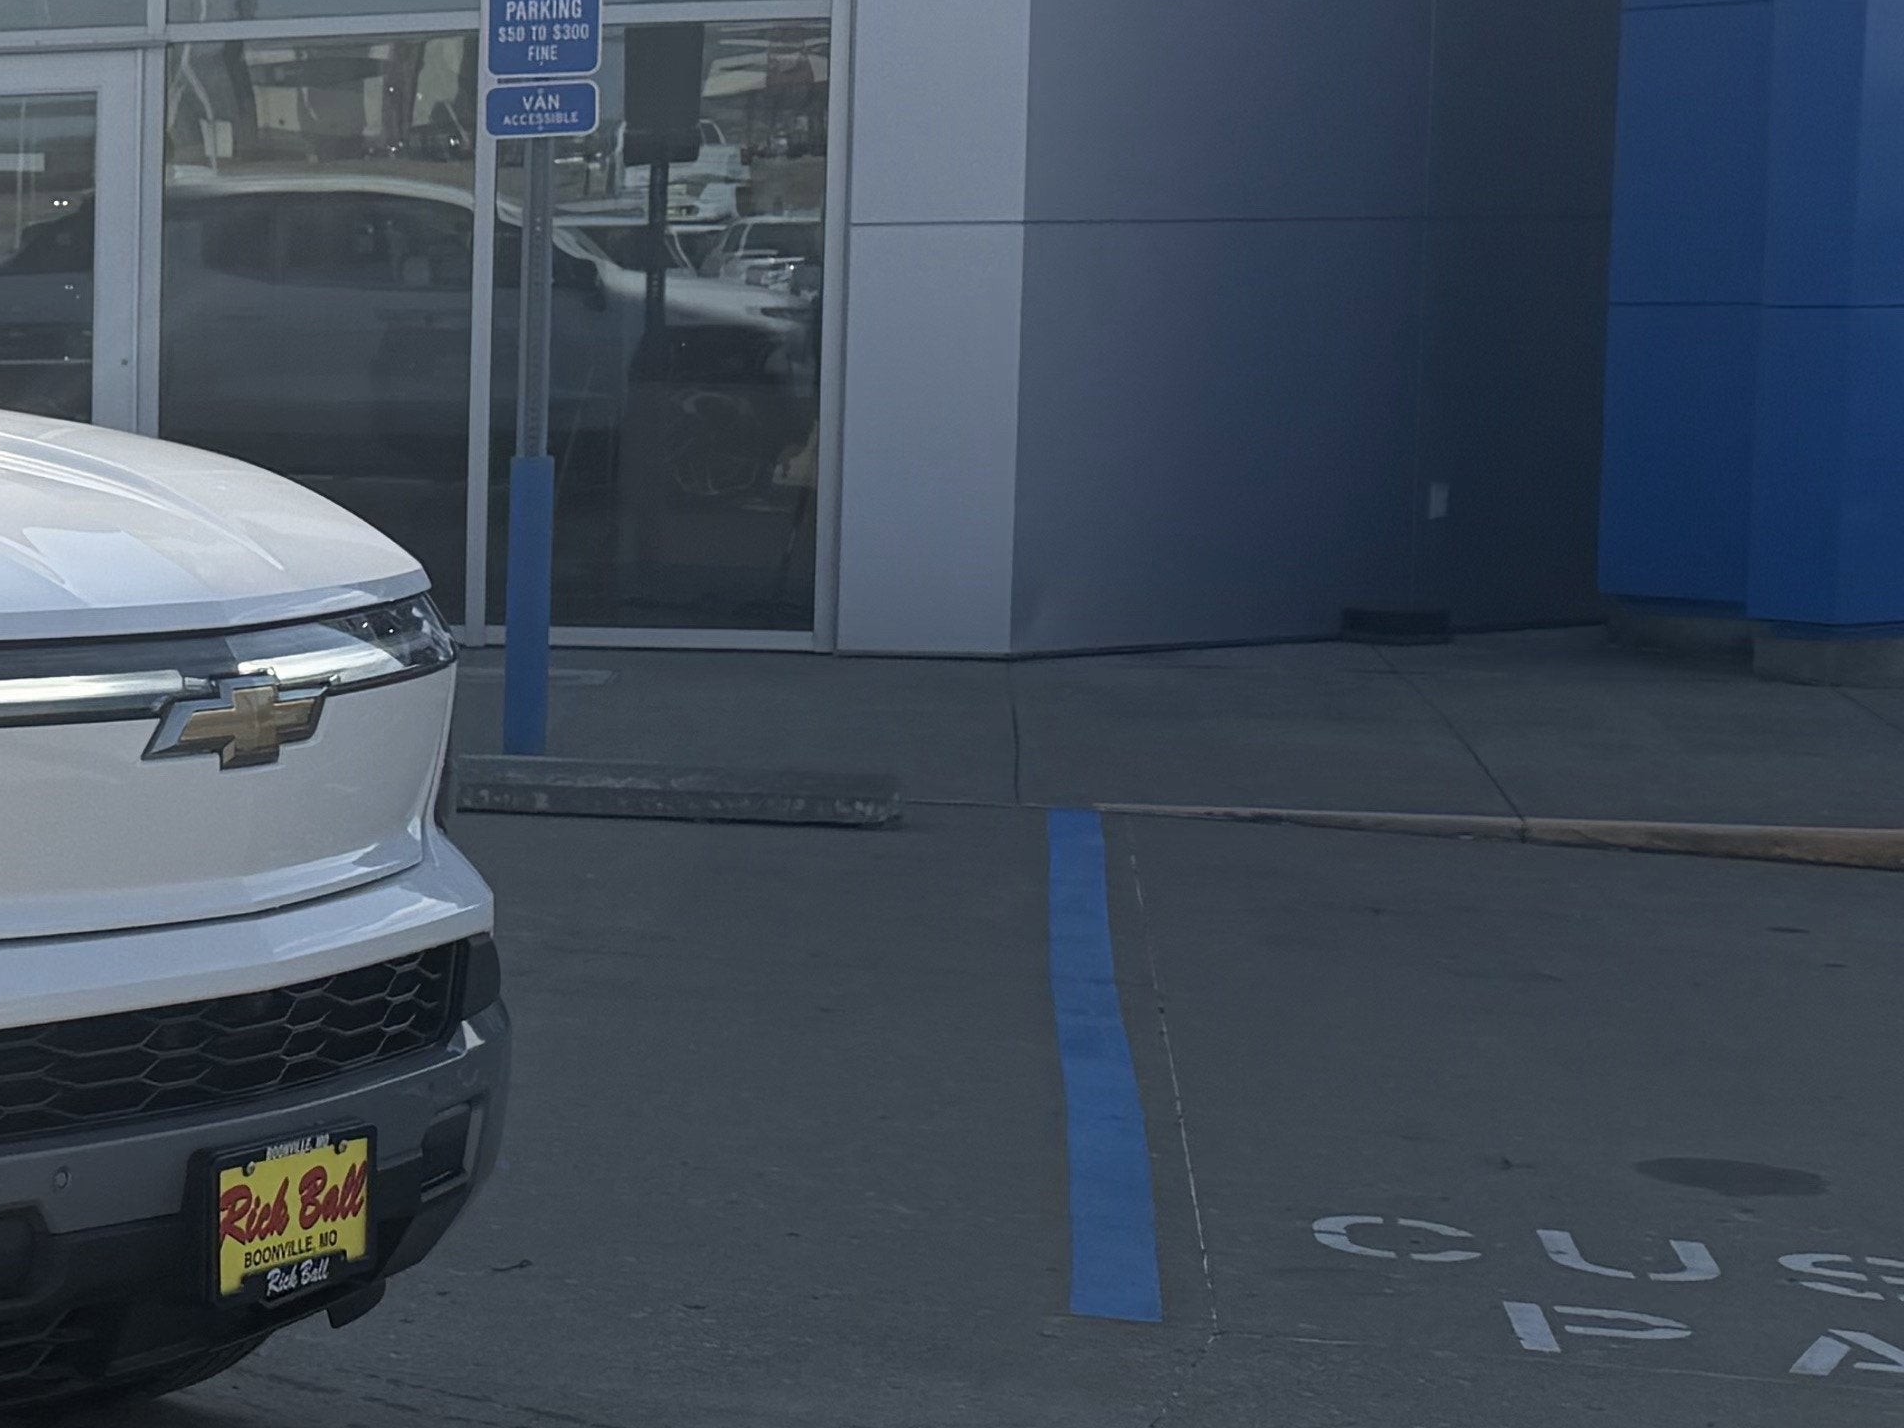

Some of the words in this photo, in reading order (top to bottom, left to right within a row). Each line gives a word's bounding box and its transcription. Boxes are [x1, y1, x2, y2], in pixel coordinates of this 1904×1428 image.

[498, 26, 525, 43] $50
[531, 25, 547, 42] TO
[553, 23, 589, 40] $300
[528, 45, 558, 62] FINE
[522, 94, 560, 110] VAN
[502, 111, 579, 126] ACCESSIBLE
[219, 1176, 290, 1245] Rick
[298, 1160, 368, 1230] Ball
[319, 1229, 338, 1249] MO
[266, 1264, 298, 1296] Rick
[298, 1257, 330, 1284] Ball
